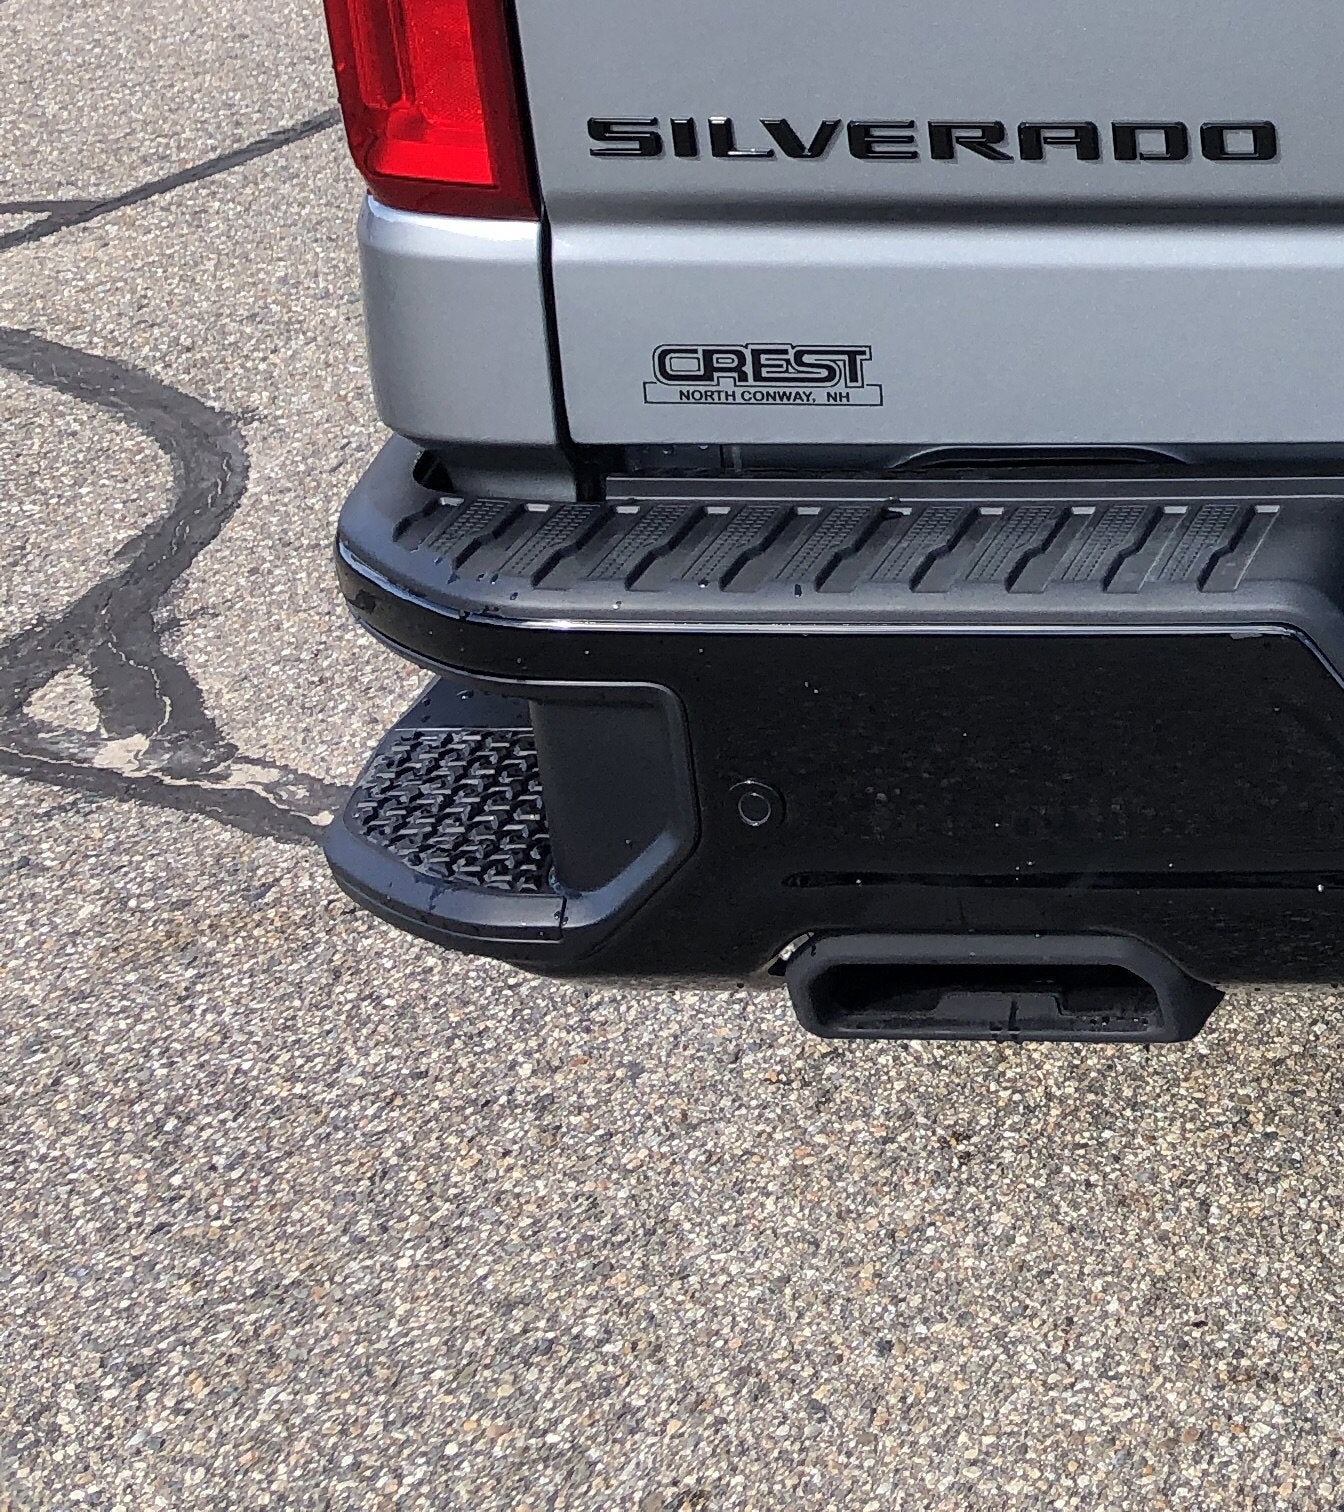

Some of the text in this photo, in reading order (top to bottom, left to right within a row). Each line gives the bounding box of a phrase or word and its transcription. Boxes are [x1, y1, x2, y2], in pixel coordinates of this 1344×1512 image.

[587, 116, 1280, 163] SILVERADO
[654, 345, 871, 387] CREST
[678, 389, 851, 404] NORTH CONWAY, NH
